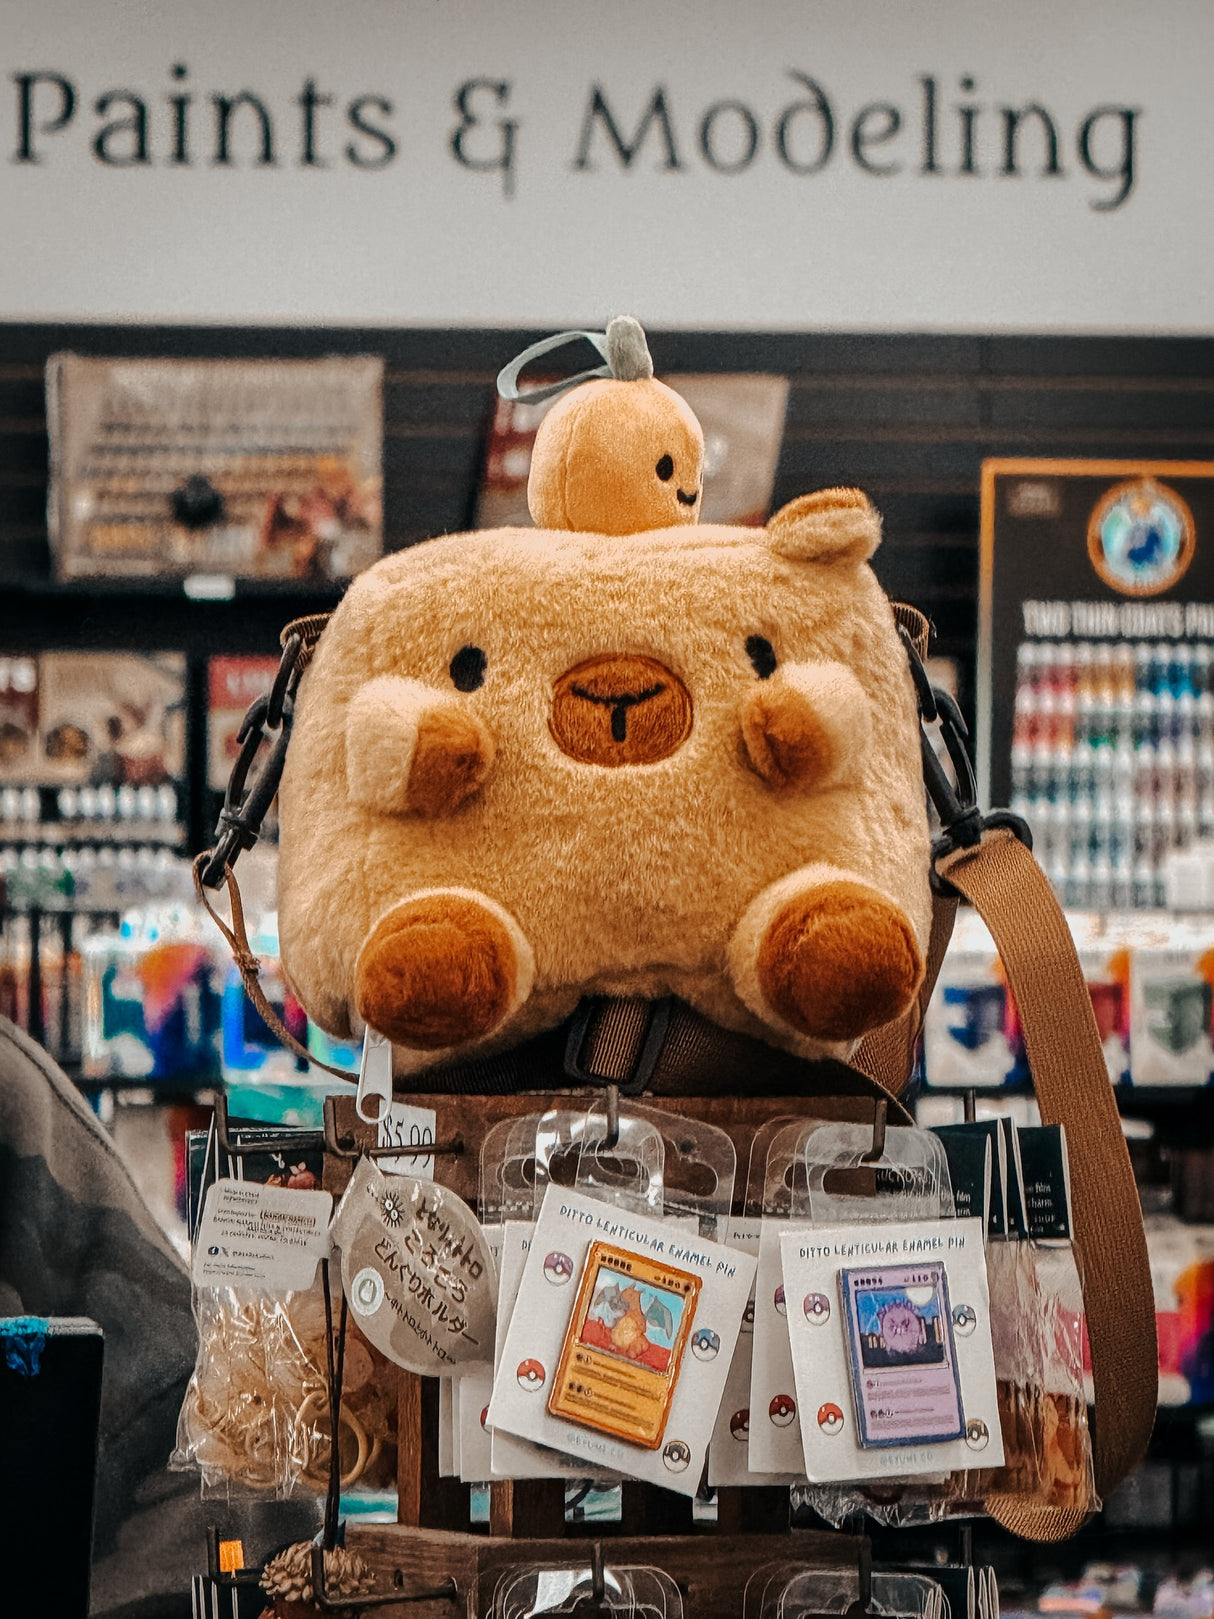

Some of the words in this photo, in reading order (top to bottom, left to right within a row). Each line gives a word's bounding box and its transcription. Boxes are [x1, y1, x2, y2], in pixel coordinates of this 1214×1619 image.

[8, 62, 398, 170] Paints
[446, 75, 518, 200] &
[572, 66, 1144, 213] Modeling
[559, 1204, 594, 1225] DITTO
[596, 1216, 665, 1254] LENTICULAR
[668, 1244, 713, 1268] ENAMEL
[715, 1260, 737, 1279] PIN
[799, 1247, 831, 1260] DITTO
[834, 1244, 899, 1259] LENTICULAR
[902, 1239, 944, 1253] ENAMEL
[948, 1234, 966, 1250] PIN
